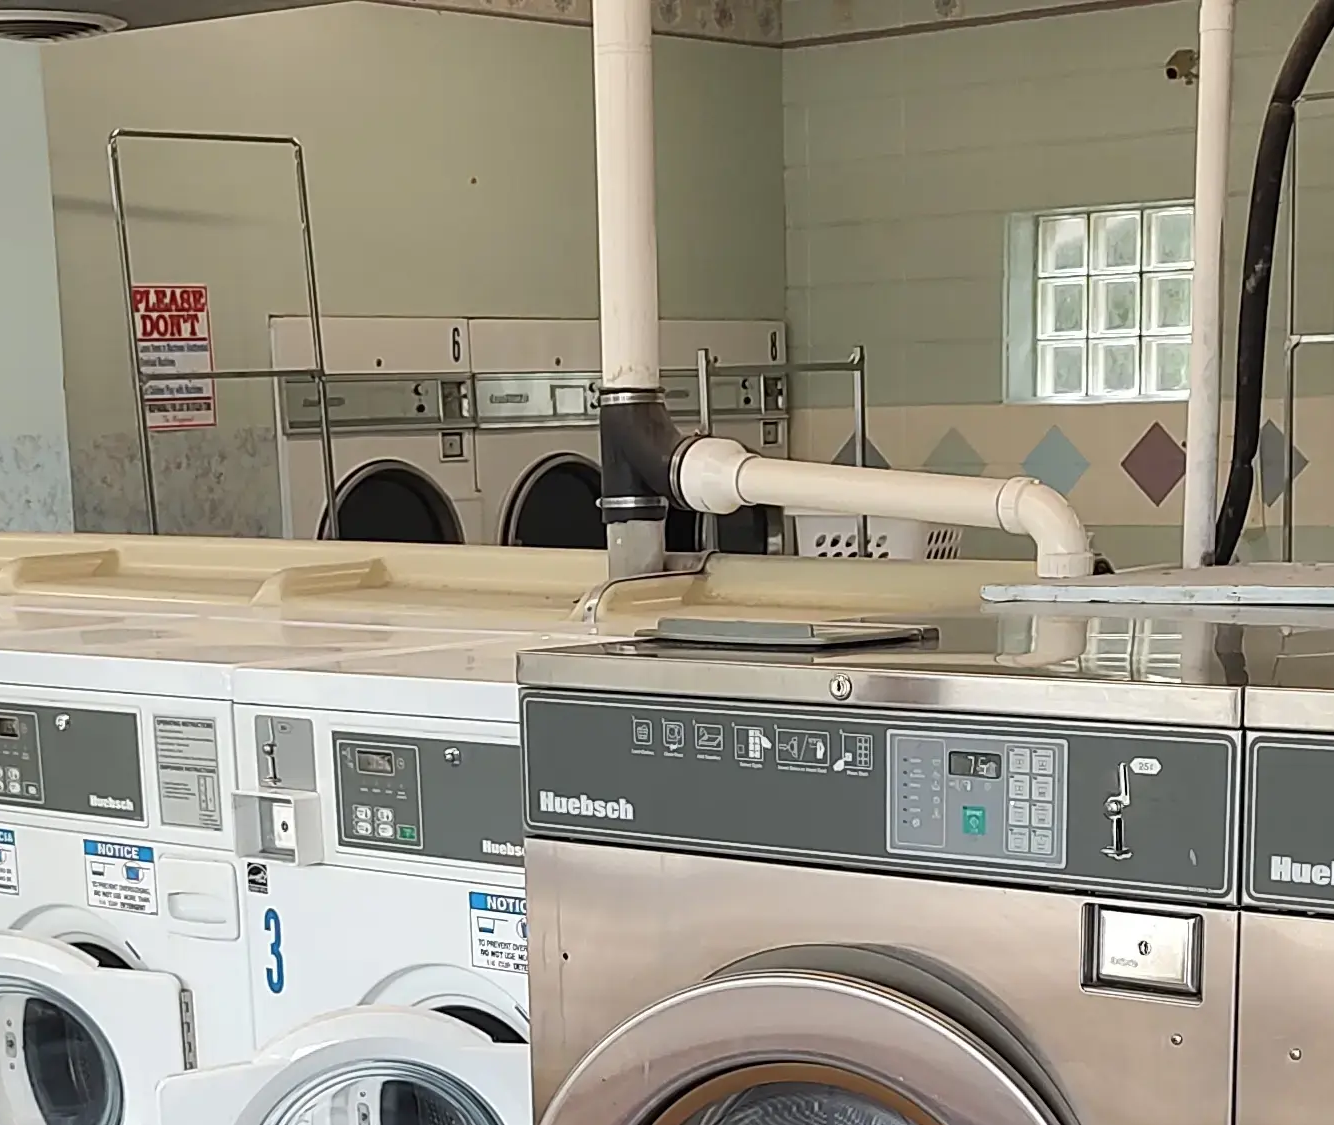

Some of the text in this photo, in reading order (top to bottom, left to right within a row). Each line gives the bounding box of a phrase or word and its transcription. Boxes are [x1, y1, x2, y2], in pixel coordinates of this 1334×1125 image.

[133, 289, 205, 313] PLEASE
[141, 314, 199, 337] DON'T
[452, 327, 461, 363] 6
[770, 331, 778, 361] 8
[539, 790, 634, 820] Huebsch
[98, 843, 140, 860] NOTICE
[482, 839, 525, 857] Huebs
[486, 895, 528, 914] NOTIC
[264, 907, 284, 994] 3
[512, 941, 528, 952] OVER
